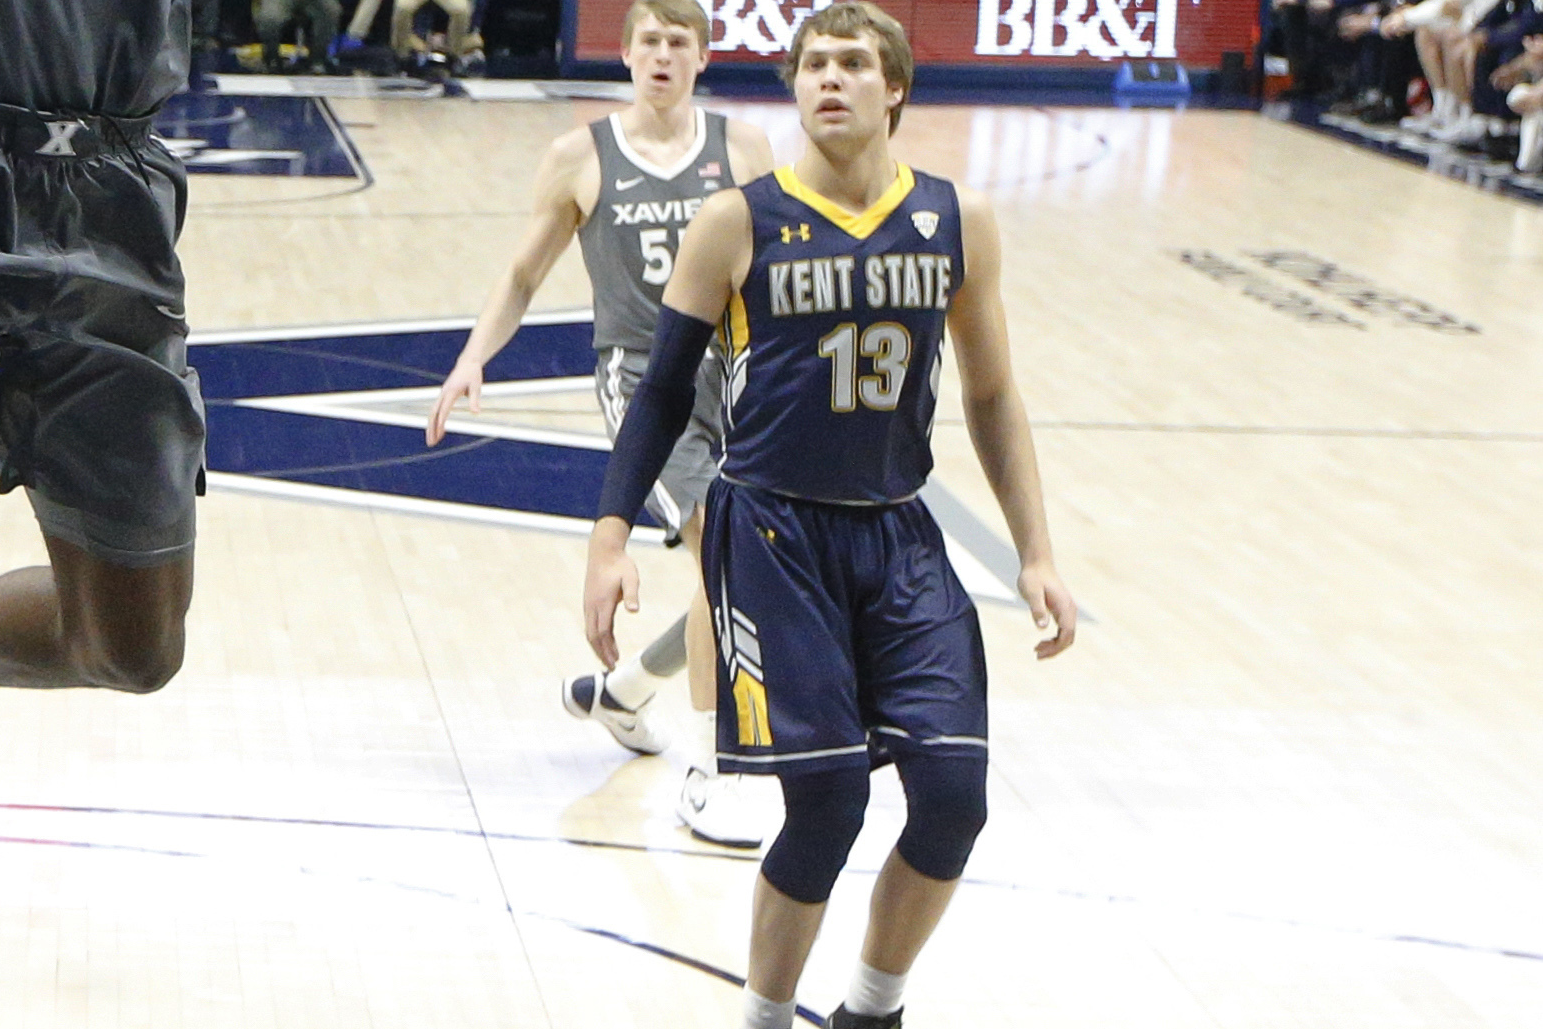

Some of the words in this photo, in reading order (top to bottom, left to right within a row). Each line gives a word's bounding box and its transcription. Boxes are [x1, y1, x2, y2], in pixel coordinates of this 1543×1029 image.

[611, 197, 709, 226] XAVIE
[639, 227, 687, 285] 5
[768, 255, 855, 318] KENT
[864, 253, 951, 310] STATE
[818, 322, 912, 413] 13
